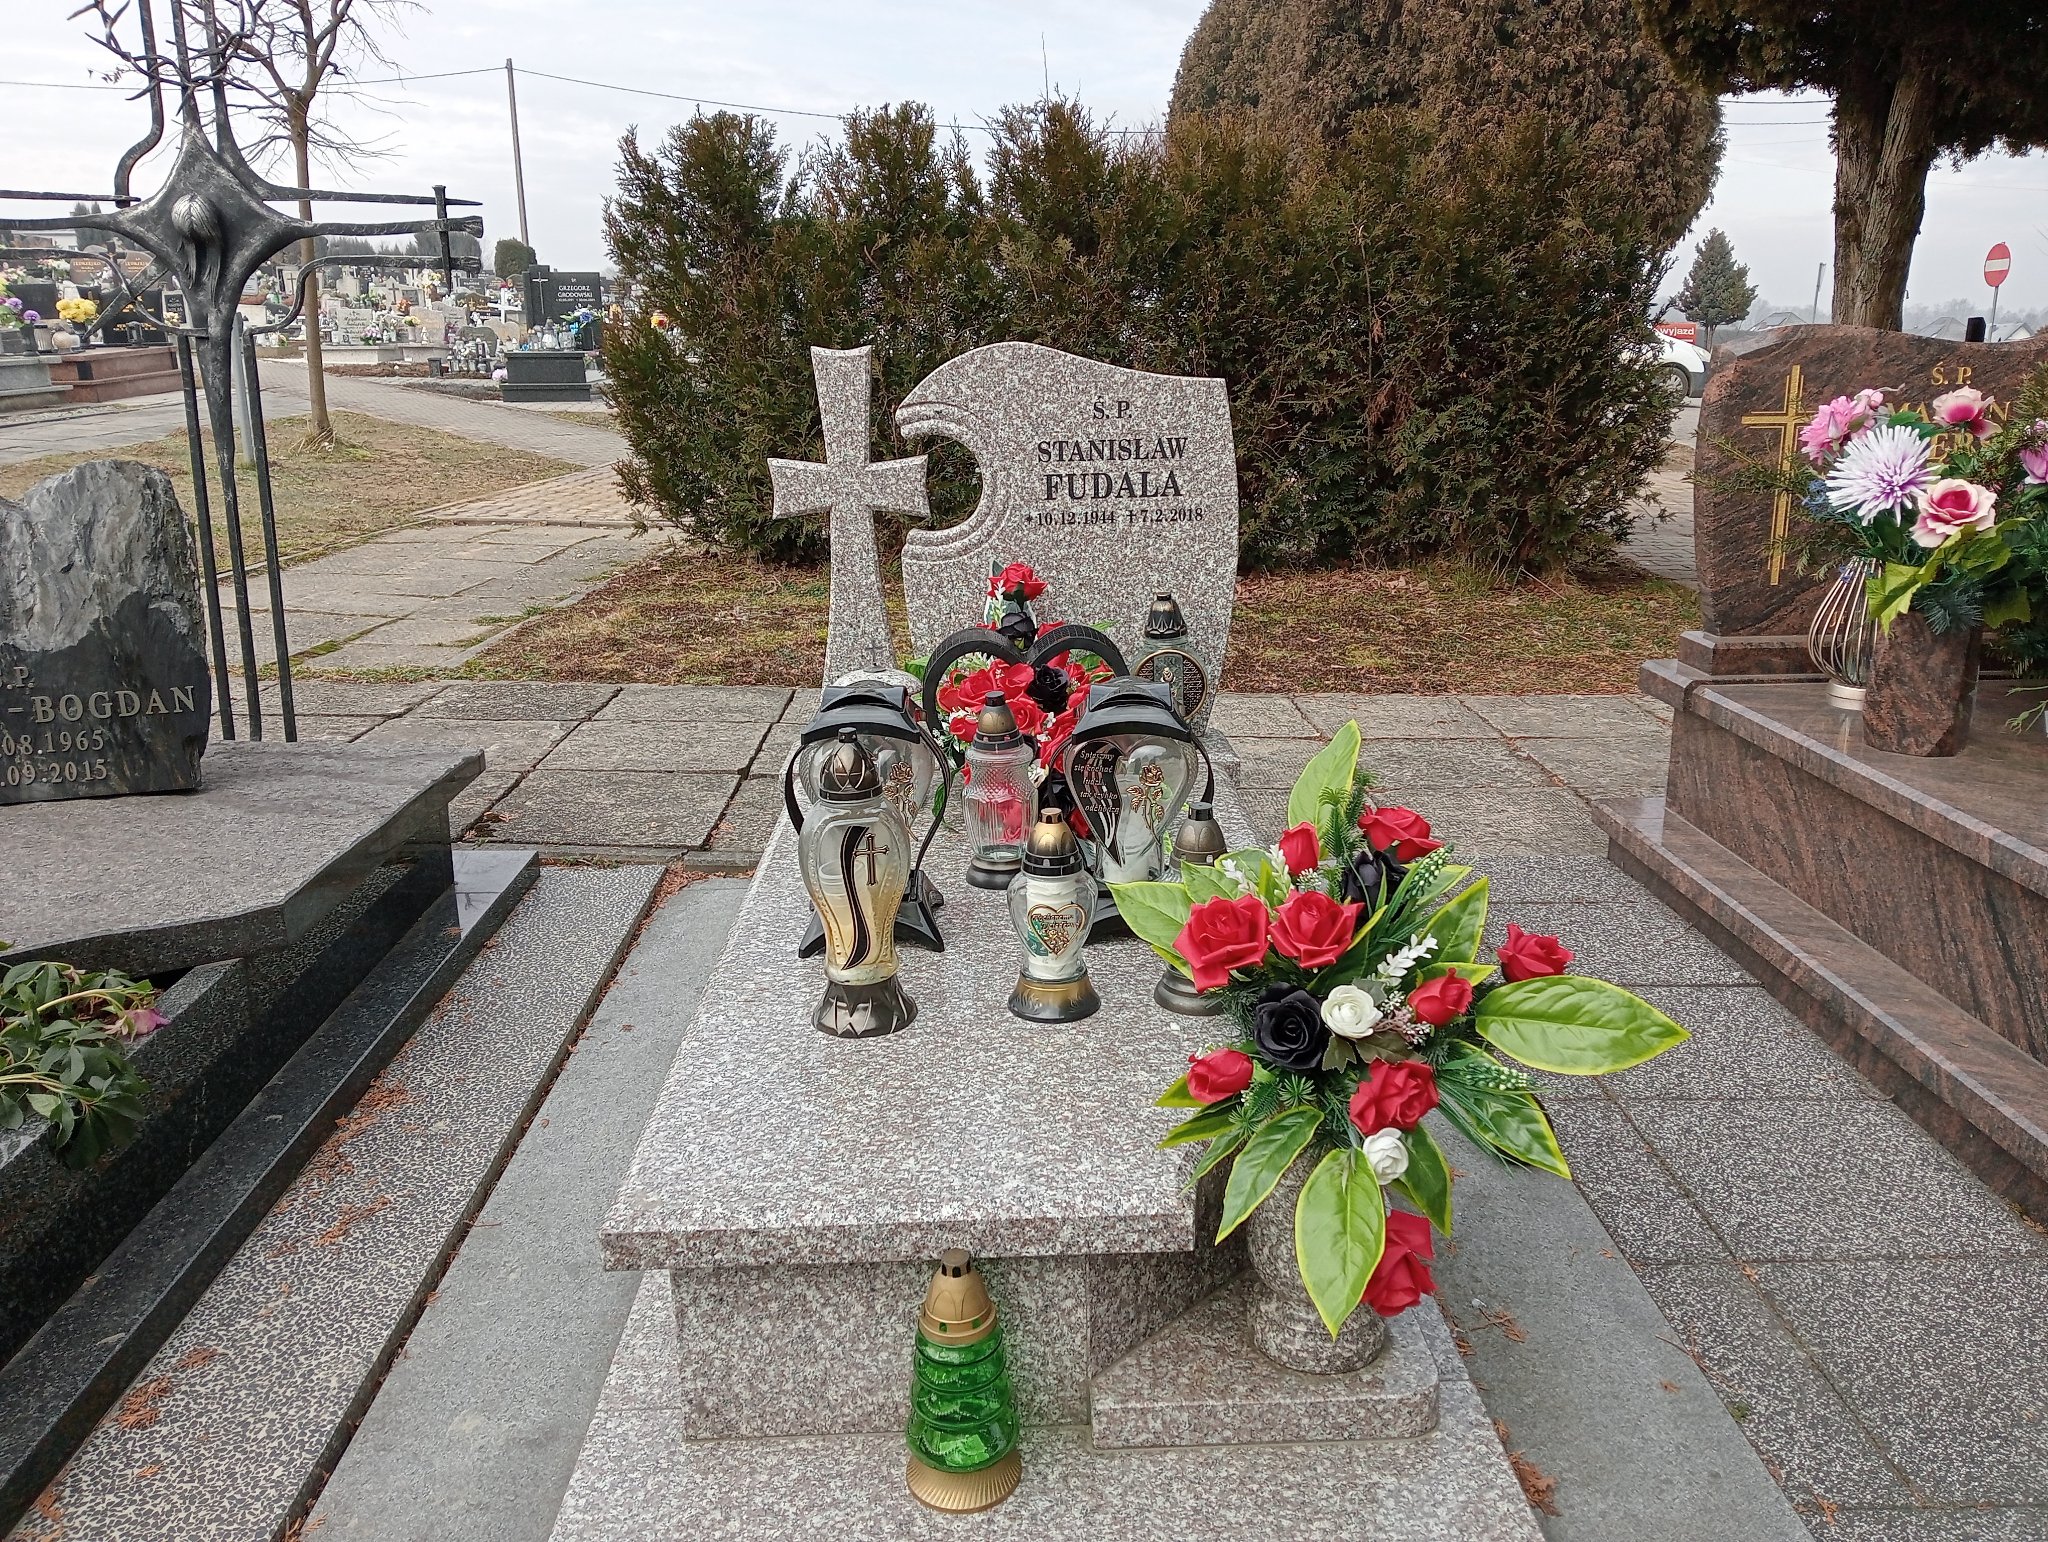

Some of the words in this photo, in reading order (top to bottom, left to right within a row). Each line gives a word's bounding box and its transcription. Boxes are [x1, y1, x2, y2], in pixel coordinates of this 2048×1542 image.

[1660, 326, 1695, 337] wyjazd
[1037, 437, 1188, 463] STANISŁAW
[1044, 471, 1183, 501] FUDALA
